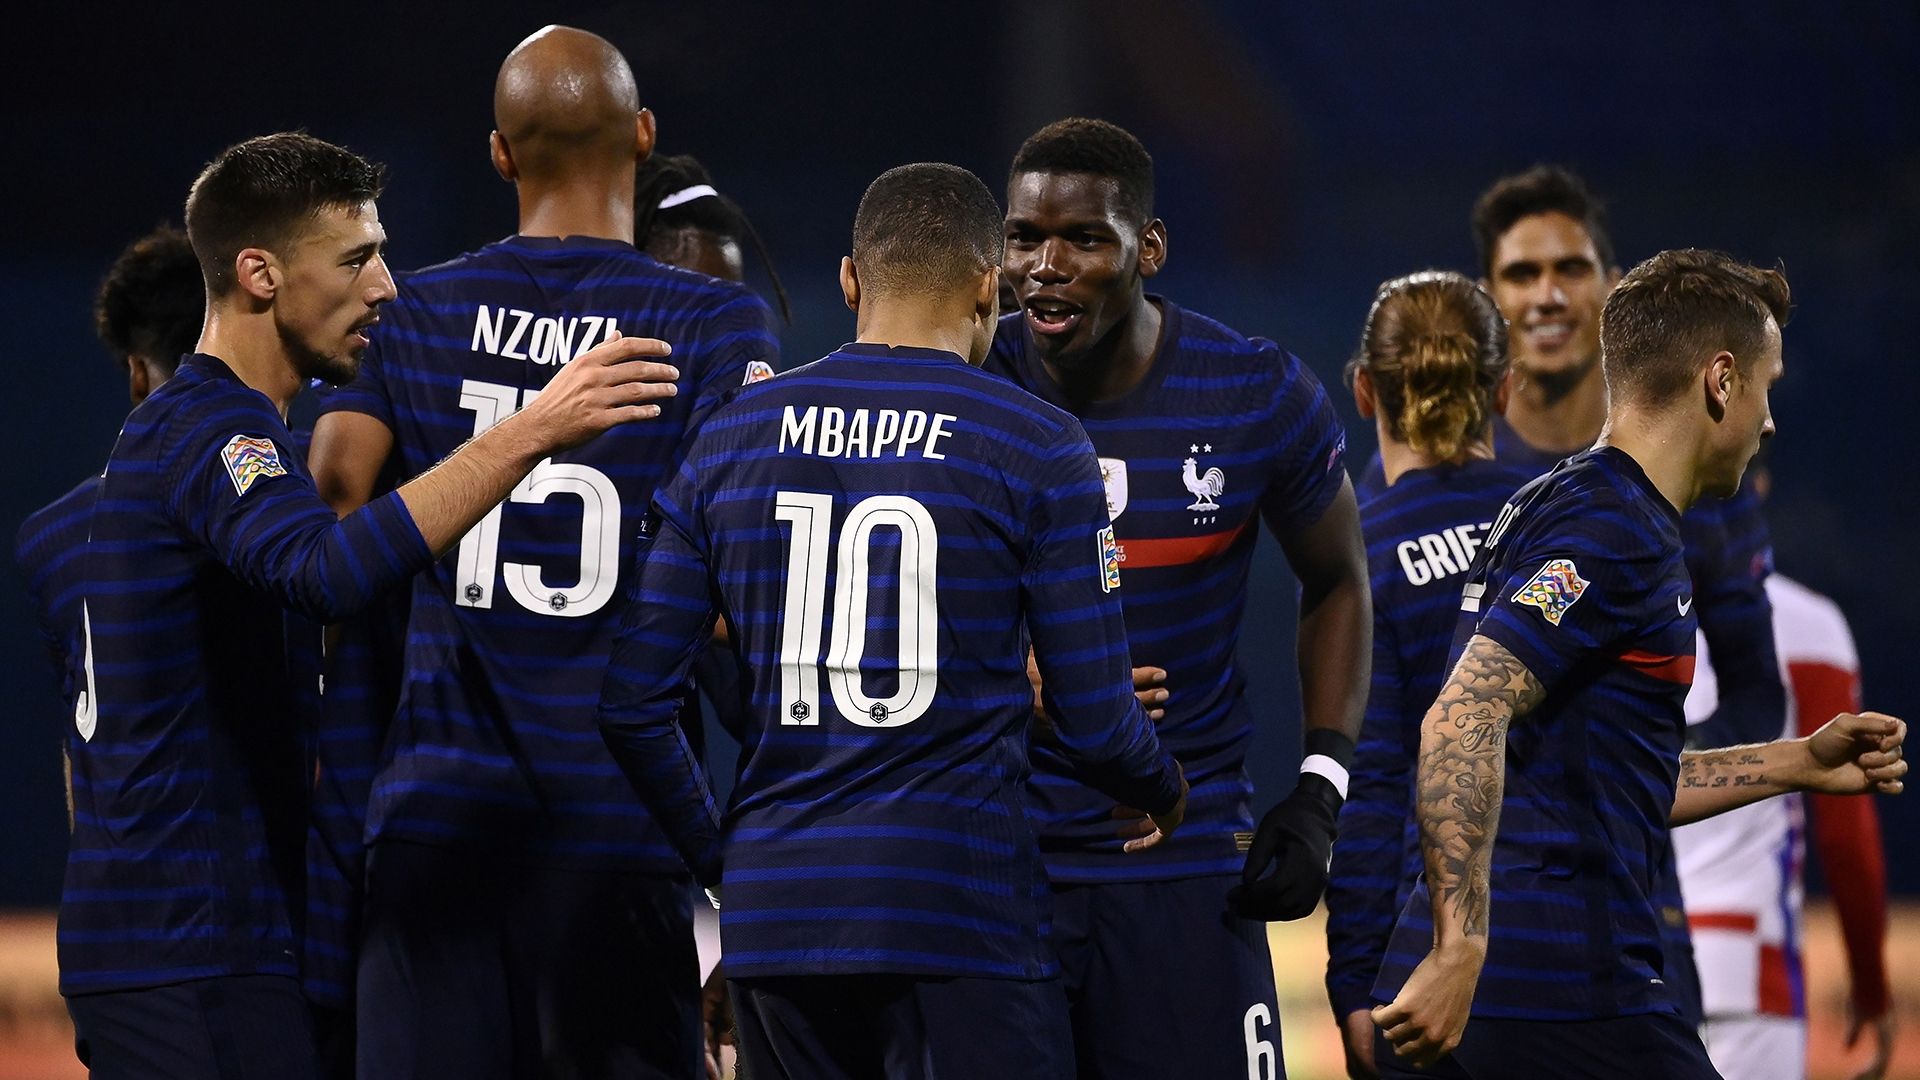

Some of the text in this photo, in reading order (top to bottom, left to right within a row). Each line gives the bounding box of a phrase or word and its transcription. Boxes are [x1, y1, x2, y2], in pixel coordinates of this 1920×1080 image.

[778, 405, 958, 460] MBAPPE
[455, 379, 621, 617] 15
[1397, 522, 1492, 586] GRIE
[775, 491, 938, 728] 10
[1243, 1003, 1276, 1080] 6
